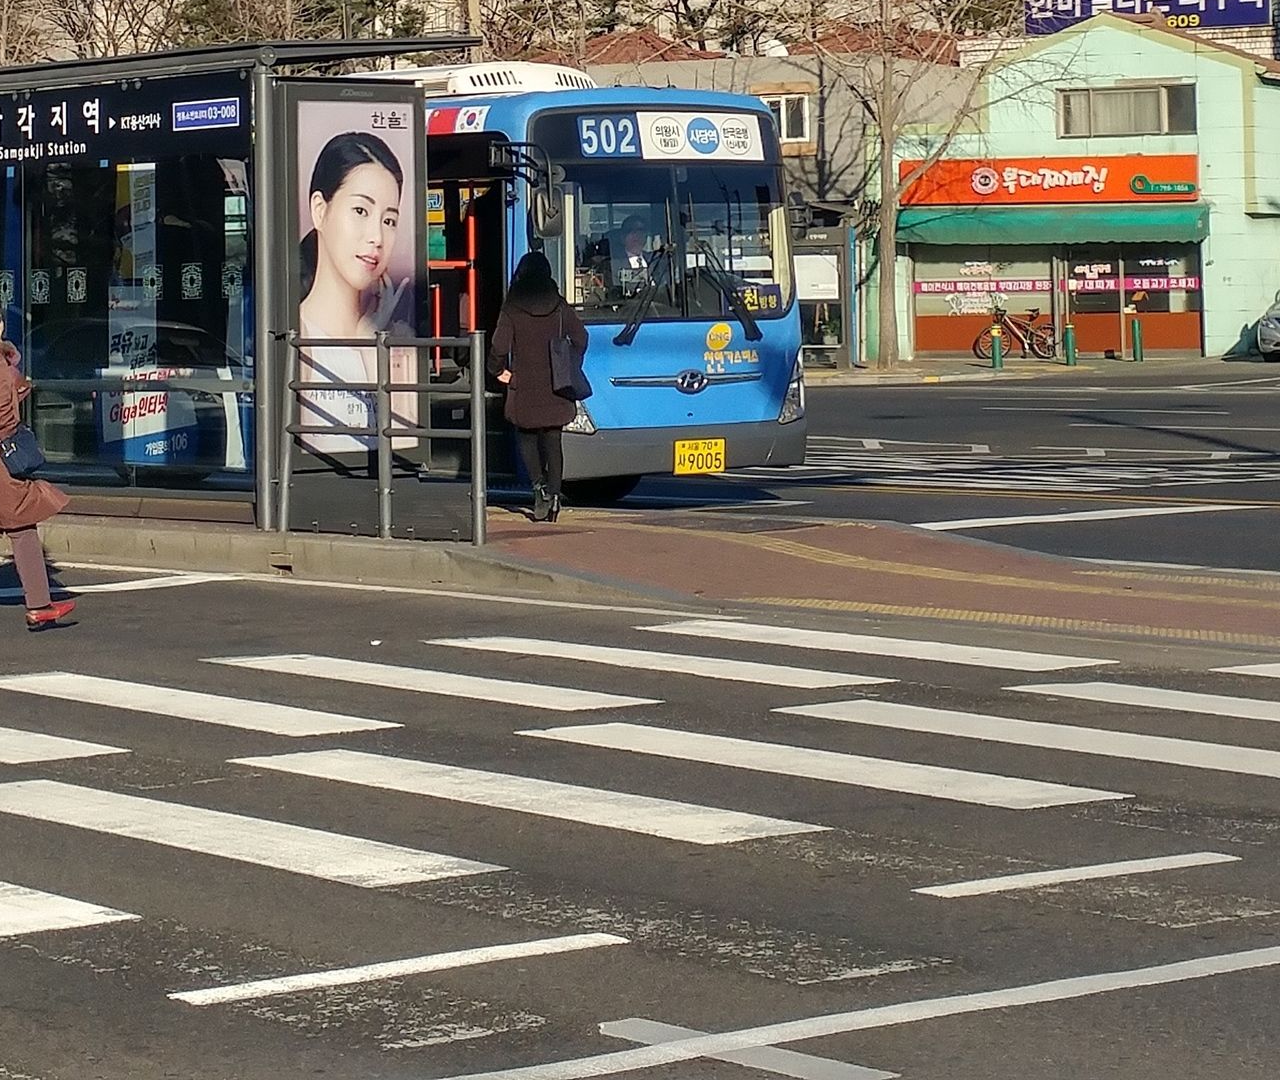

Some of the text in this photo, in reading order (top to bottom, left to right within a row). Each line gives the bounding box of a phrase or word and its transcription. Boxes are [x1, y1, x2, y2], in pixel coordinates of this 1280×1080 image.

[207, 104, 236, 120] 03-008
[581, 117, 636, 155] 502
[655, 124, 680, 138] 의왕시
[689, 128, 719, 144] 사당역
[47, 141, 87, 157] Station
[710, 332, 730, 341] CNG
[109, 392, 169, 424] Giga인터넷
[171, 433, 189, 452] 106
[701, 441, 713, 451] 70
[687, 452, 722, 471] 9005
